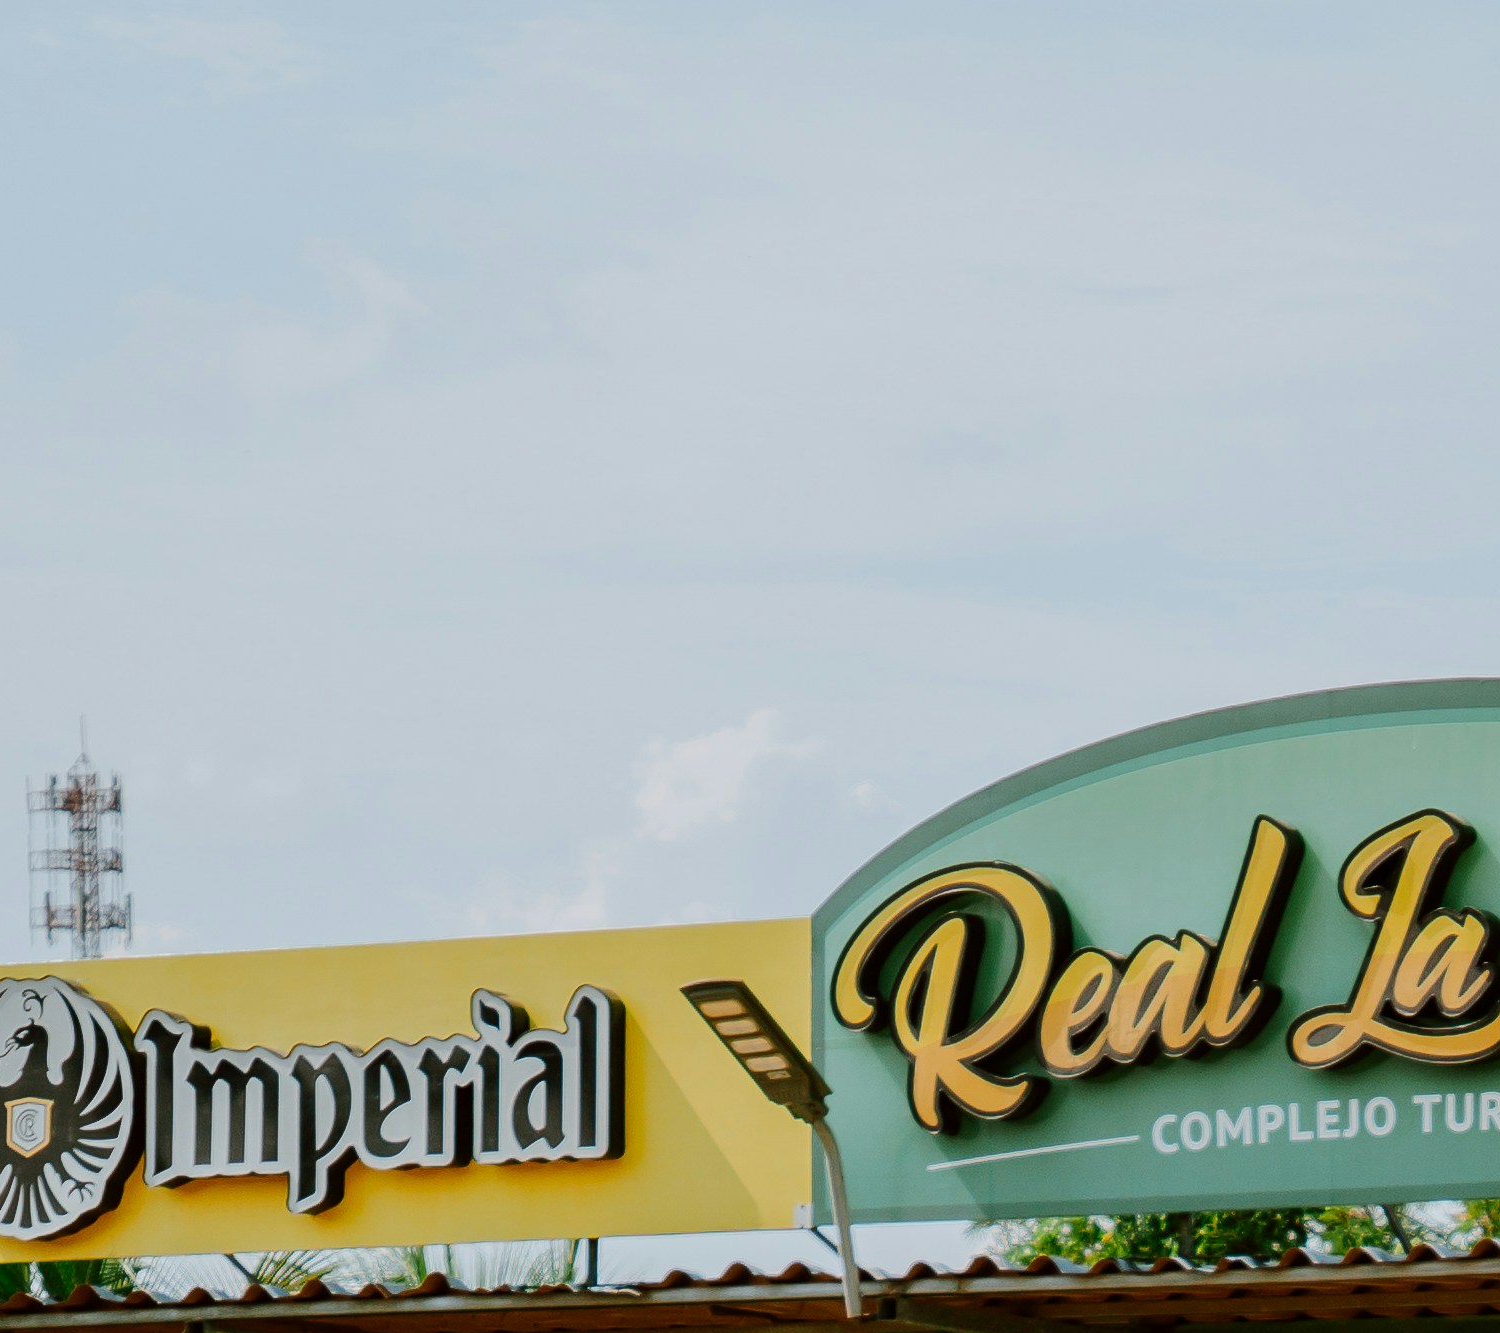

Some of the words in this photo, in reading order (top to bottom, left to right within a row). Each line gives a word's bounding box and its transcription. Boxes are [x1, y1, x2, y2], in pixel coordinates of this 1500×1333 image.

[833, 814, 1298, 1134] Real
[143, 988, 610, 1208] Imperial
[1150, 1094, 1398, 1155] COMPLEJO
